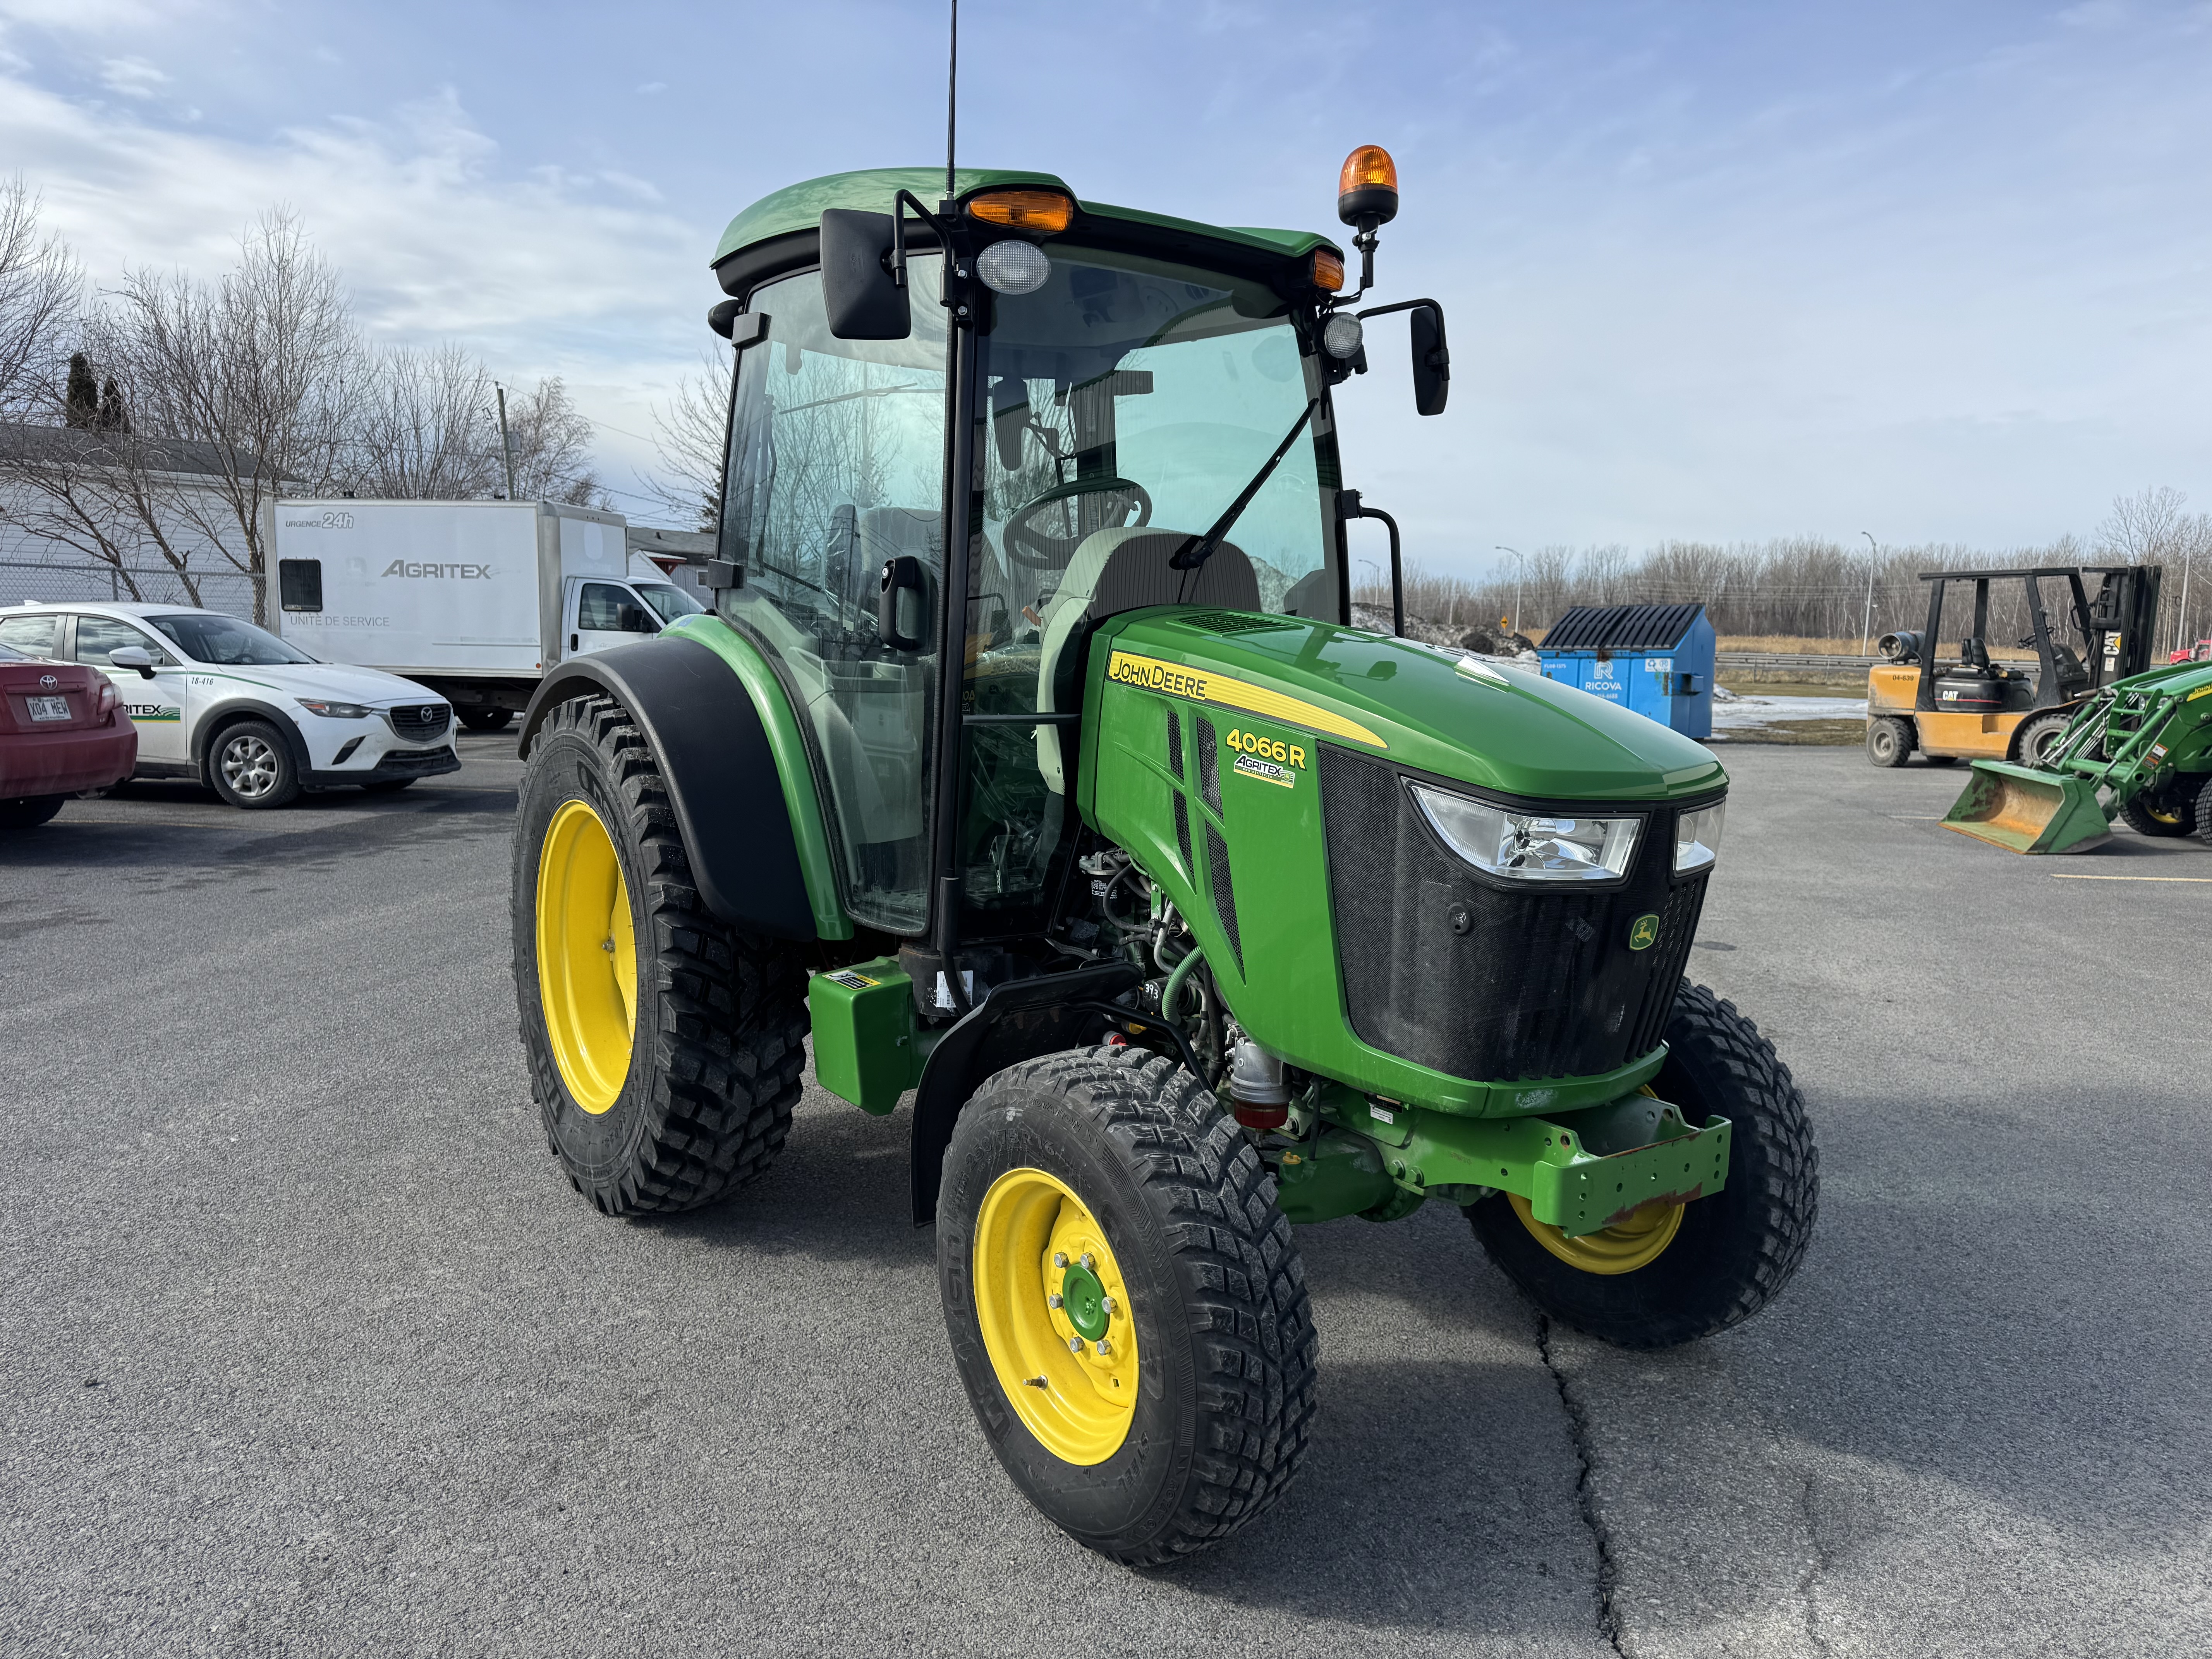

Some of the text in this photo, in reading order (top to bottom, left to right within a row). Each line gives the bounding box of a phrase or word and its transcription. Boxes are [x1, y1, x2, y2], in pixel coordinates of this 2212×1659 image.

[322, 512, 354, 529] 24h
[381, 559, 491, 579] AGRITEX
[326, 616, 340, 626] DE
[343, 617, 390, 627] SERVICE
[2103, 630, 2121, 655] CAT
[1113, 658, 1207, 697] JOHN DEERE
[1585, 682, 1622, 690] RICOVA
[2192, 684, 2211, 694] JOHN
[1942, 690, 1958, 701] CAT
[30, 702, 47, 716] X04
[1236, 756, 1281, 776] AGRITEX
[1145, 983, 1158, 999] 393
[1027, 1096, 1083, 1133] ROTATION
